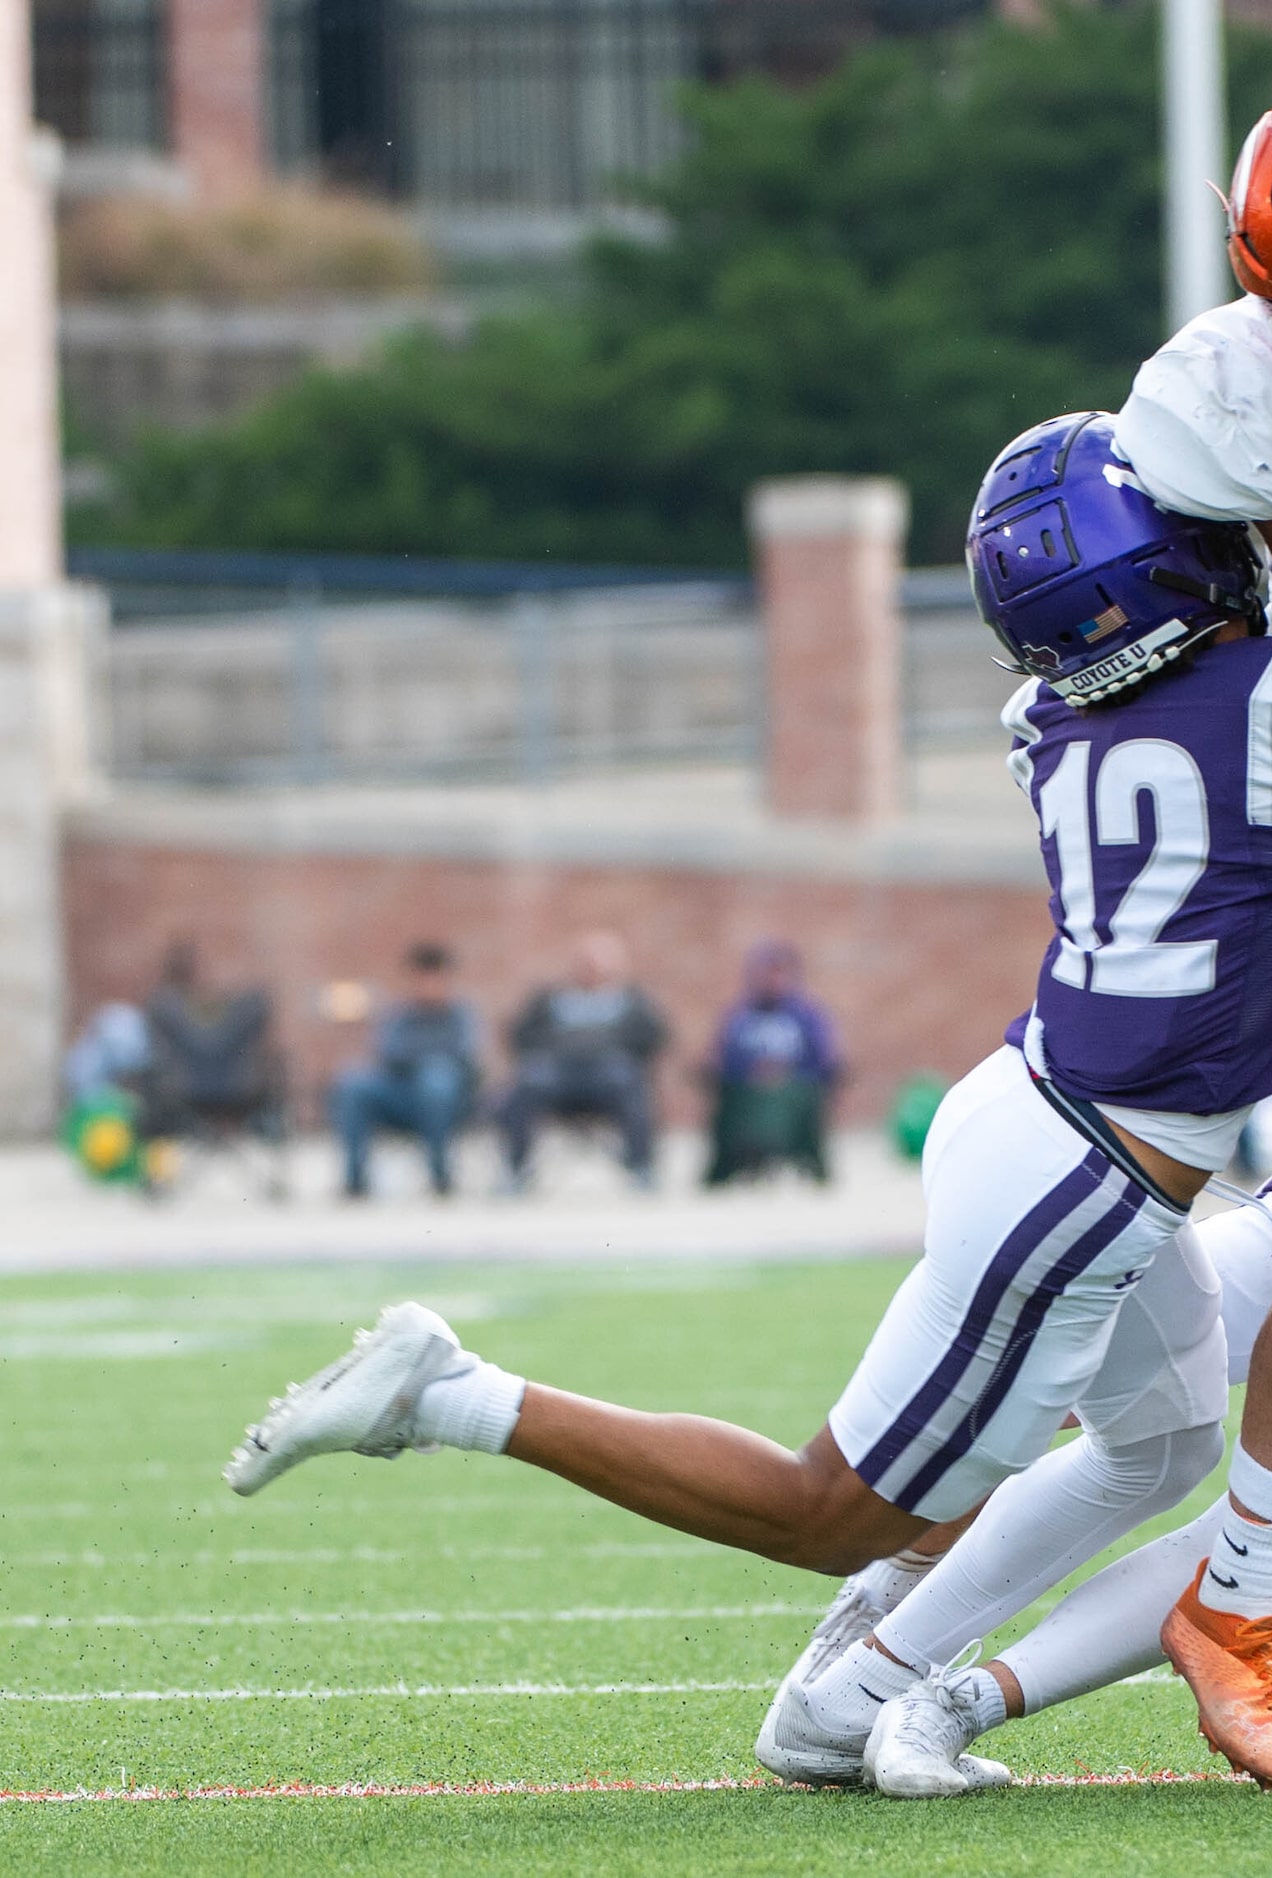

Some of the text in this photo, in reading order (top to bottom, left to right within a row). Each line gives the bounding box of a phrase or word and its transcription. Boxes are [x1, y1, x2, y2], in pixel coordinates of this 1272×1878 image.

[1070, 643, 1147, 690] COYOTE U
[1039, 737, 1218, 998] 12
